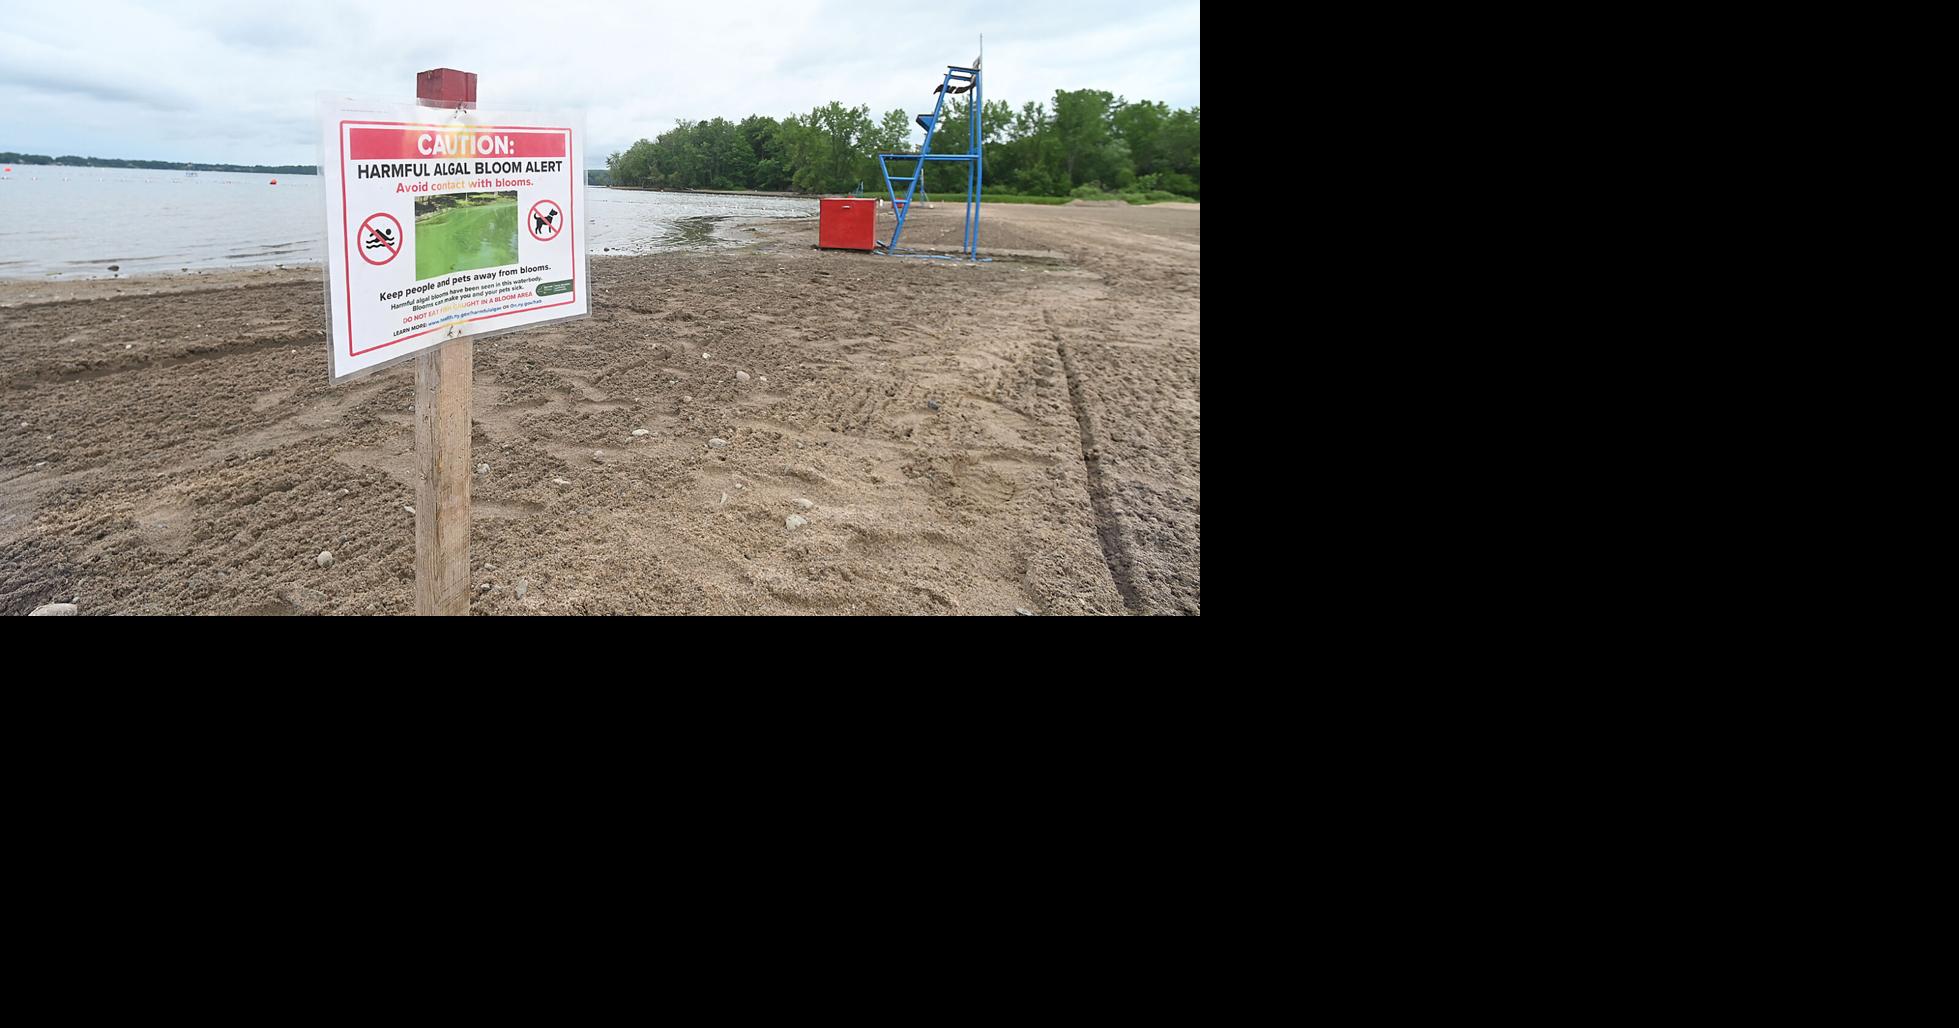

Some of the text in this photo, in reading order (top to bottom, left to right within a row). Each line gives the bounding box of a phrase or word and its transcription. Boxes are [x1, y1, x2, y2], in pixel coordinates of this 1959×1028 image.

[418, 134, 514, 155] CAUTION:
[358, 161, 562, 179] HARMFUL ALGAL BLOOM ALERT
[396, 178, 534, 193] Avoid contact with blooms.
[380, 264, 551, 302] Keep people and pets away from blooms.
[391, 299, 415, 310] Harmful
[416, 296, 430, 304] algal
[431, 291, 448, 301] blooms
[513, 276, 542, 285] waterbody.
[403, 316, 413, 324] DO
[413, 313, 427, 321] NOT
[428, 309, 439, 317] EAT
[495, 295, 516, 303] BLOOM
[517, 291, 533, 299] AREA
[412, 303, 433, 312] Blooms
[444, 295, 458, 303] make
[485, 289, 498, 297] your
[393, 327, 410, 337] LEARN
[411, 322, 427, 331] MORE:
